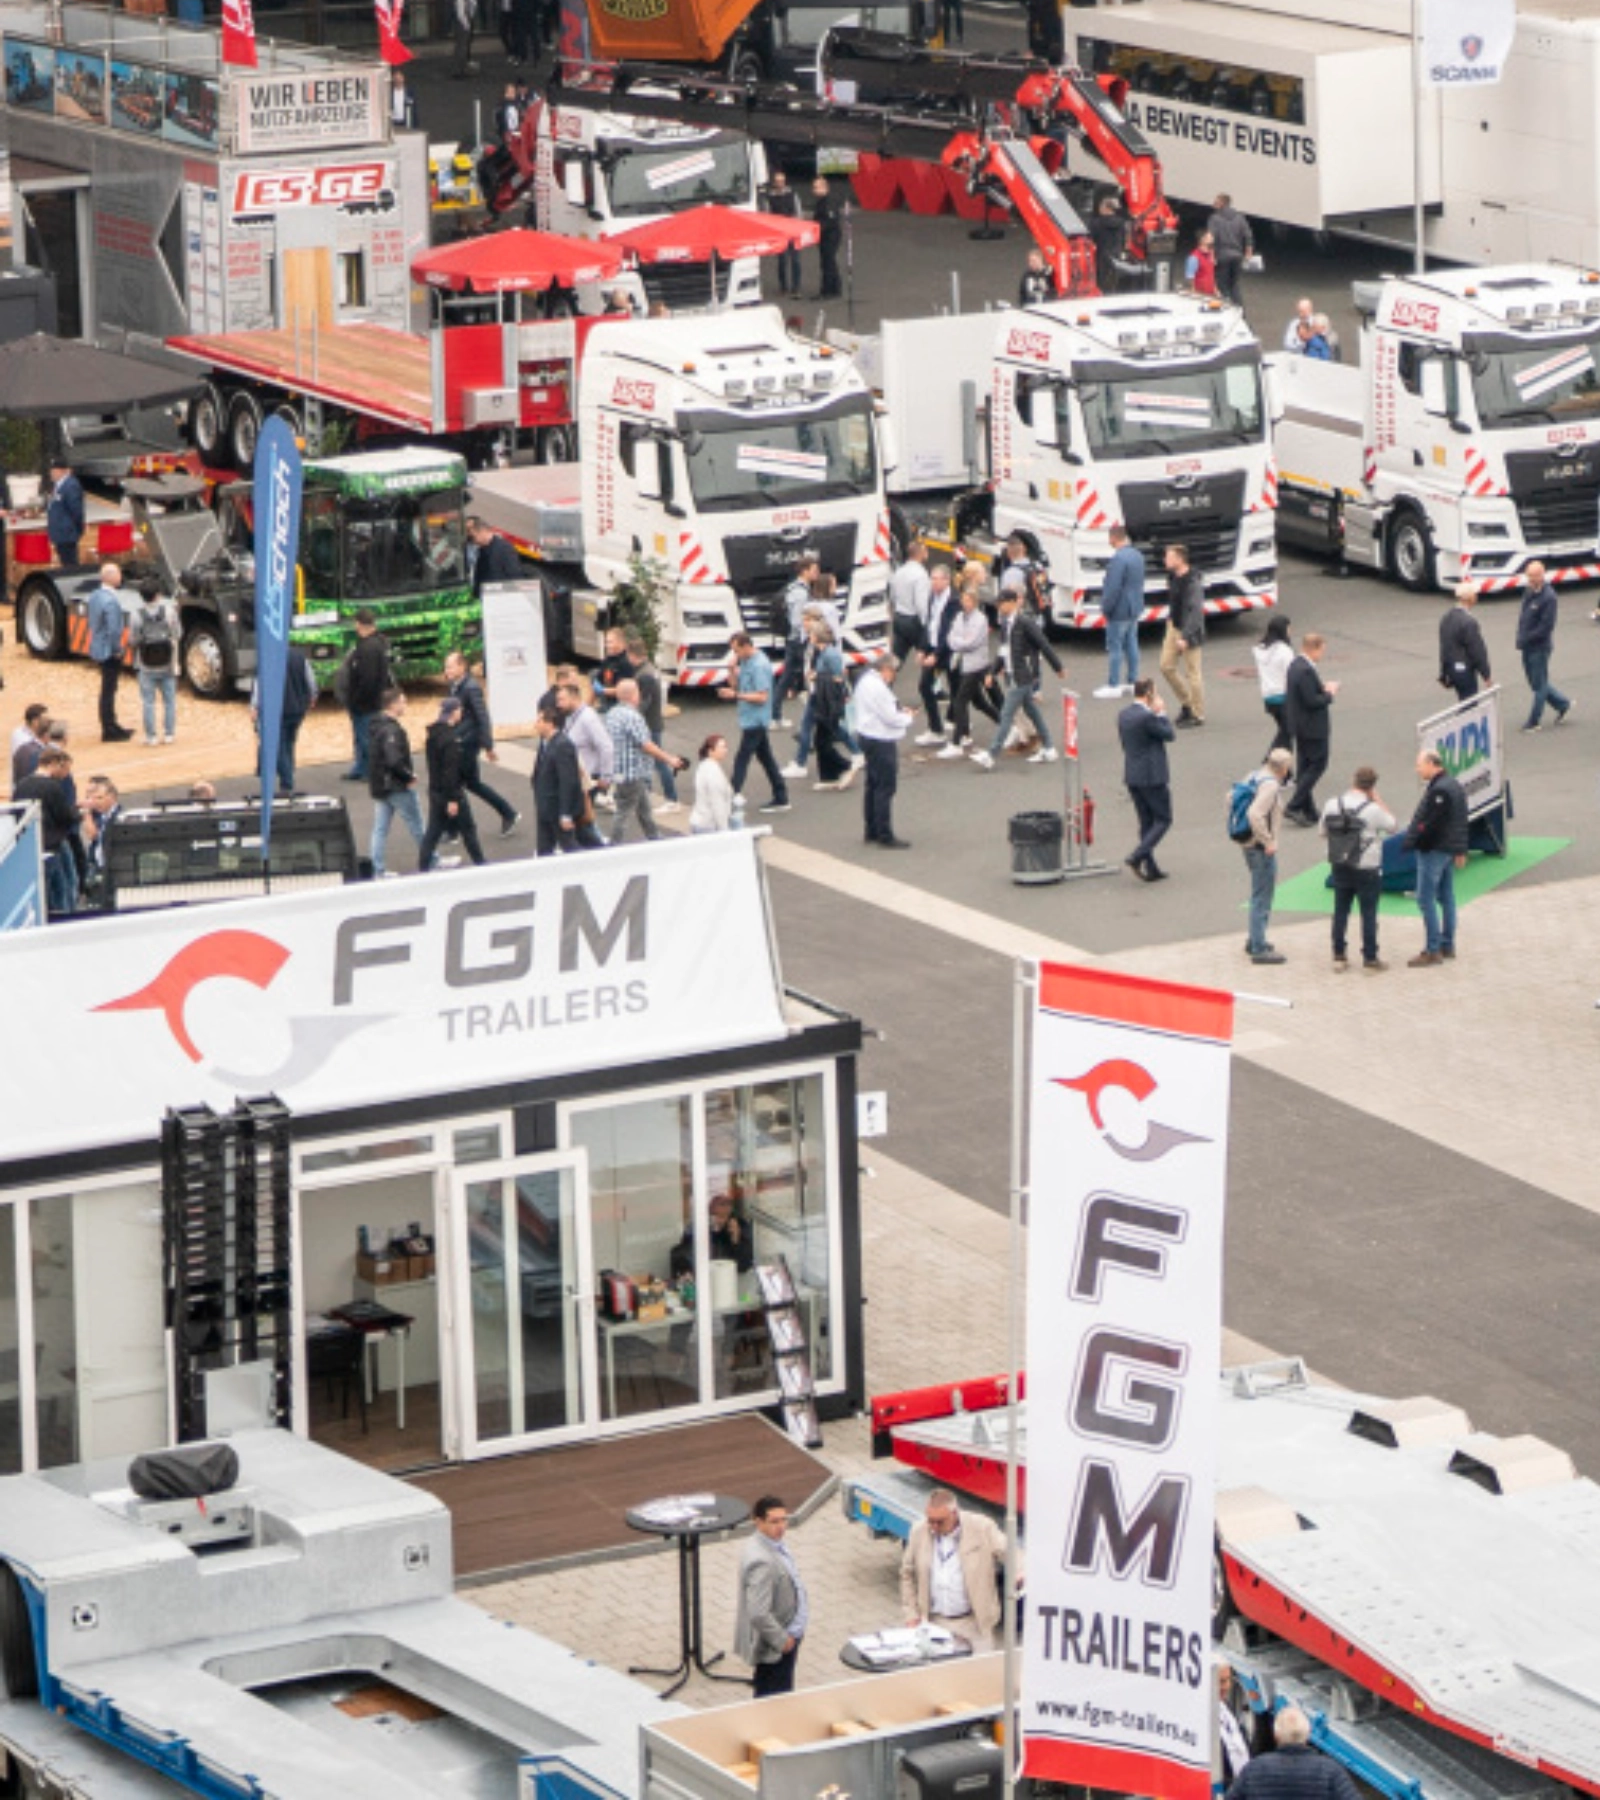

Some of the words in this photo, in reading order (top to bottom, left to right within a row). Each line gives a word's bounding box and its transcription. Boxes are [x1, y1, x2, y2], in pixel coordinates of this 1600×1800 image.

[250, 83, 296, 110] WIR
[301, 77, 369, 105] LEBEN
[1146, 105, 1230, 147] BEWEGT
[1235, 124, 1317, 165] EVENTS
[333, 874, 650, 1006] FGM
[438, 979, 650, 1041] TRAILERS
[1063, 1190, 1191, 1590] FGM
[1037, 1605, 1203, 1690] TRAILERS
